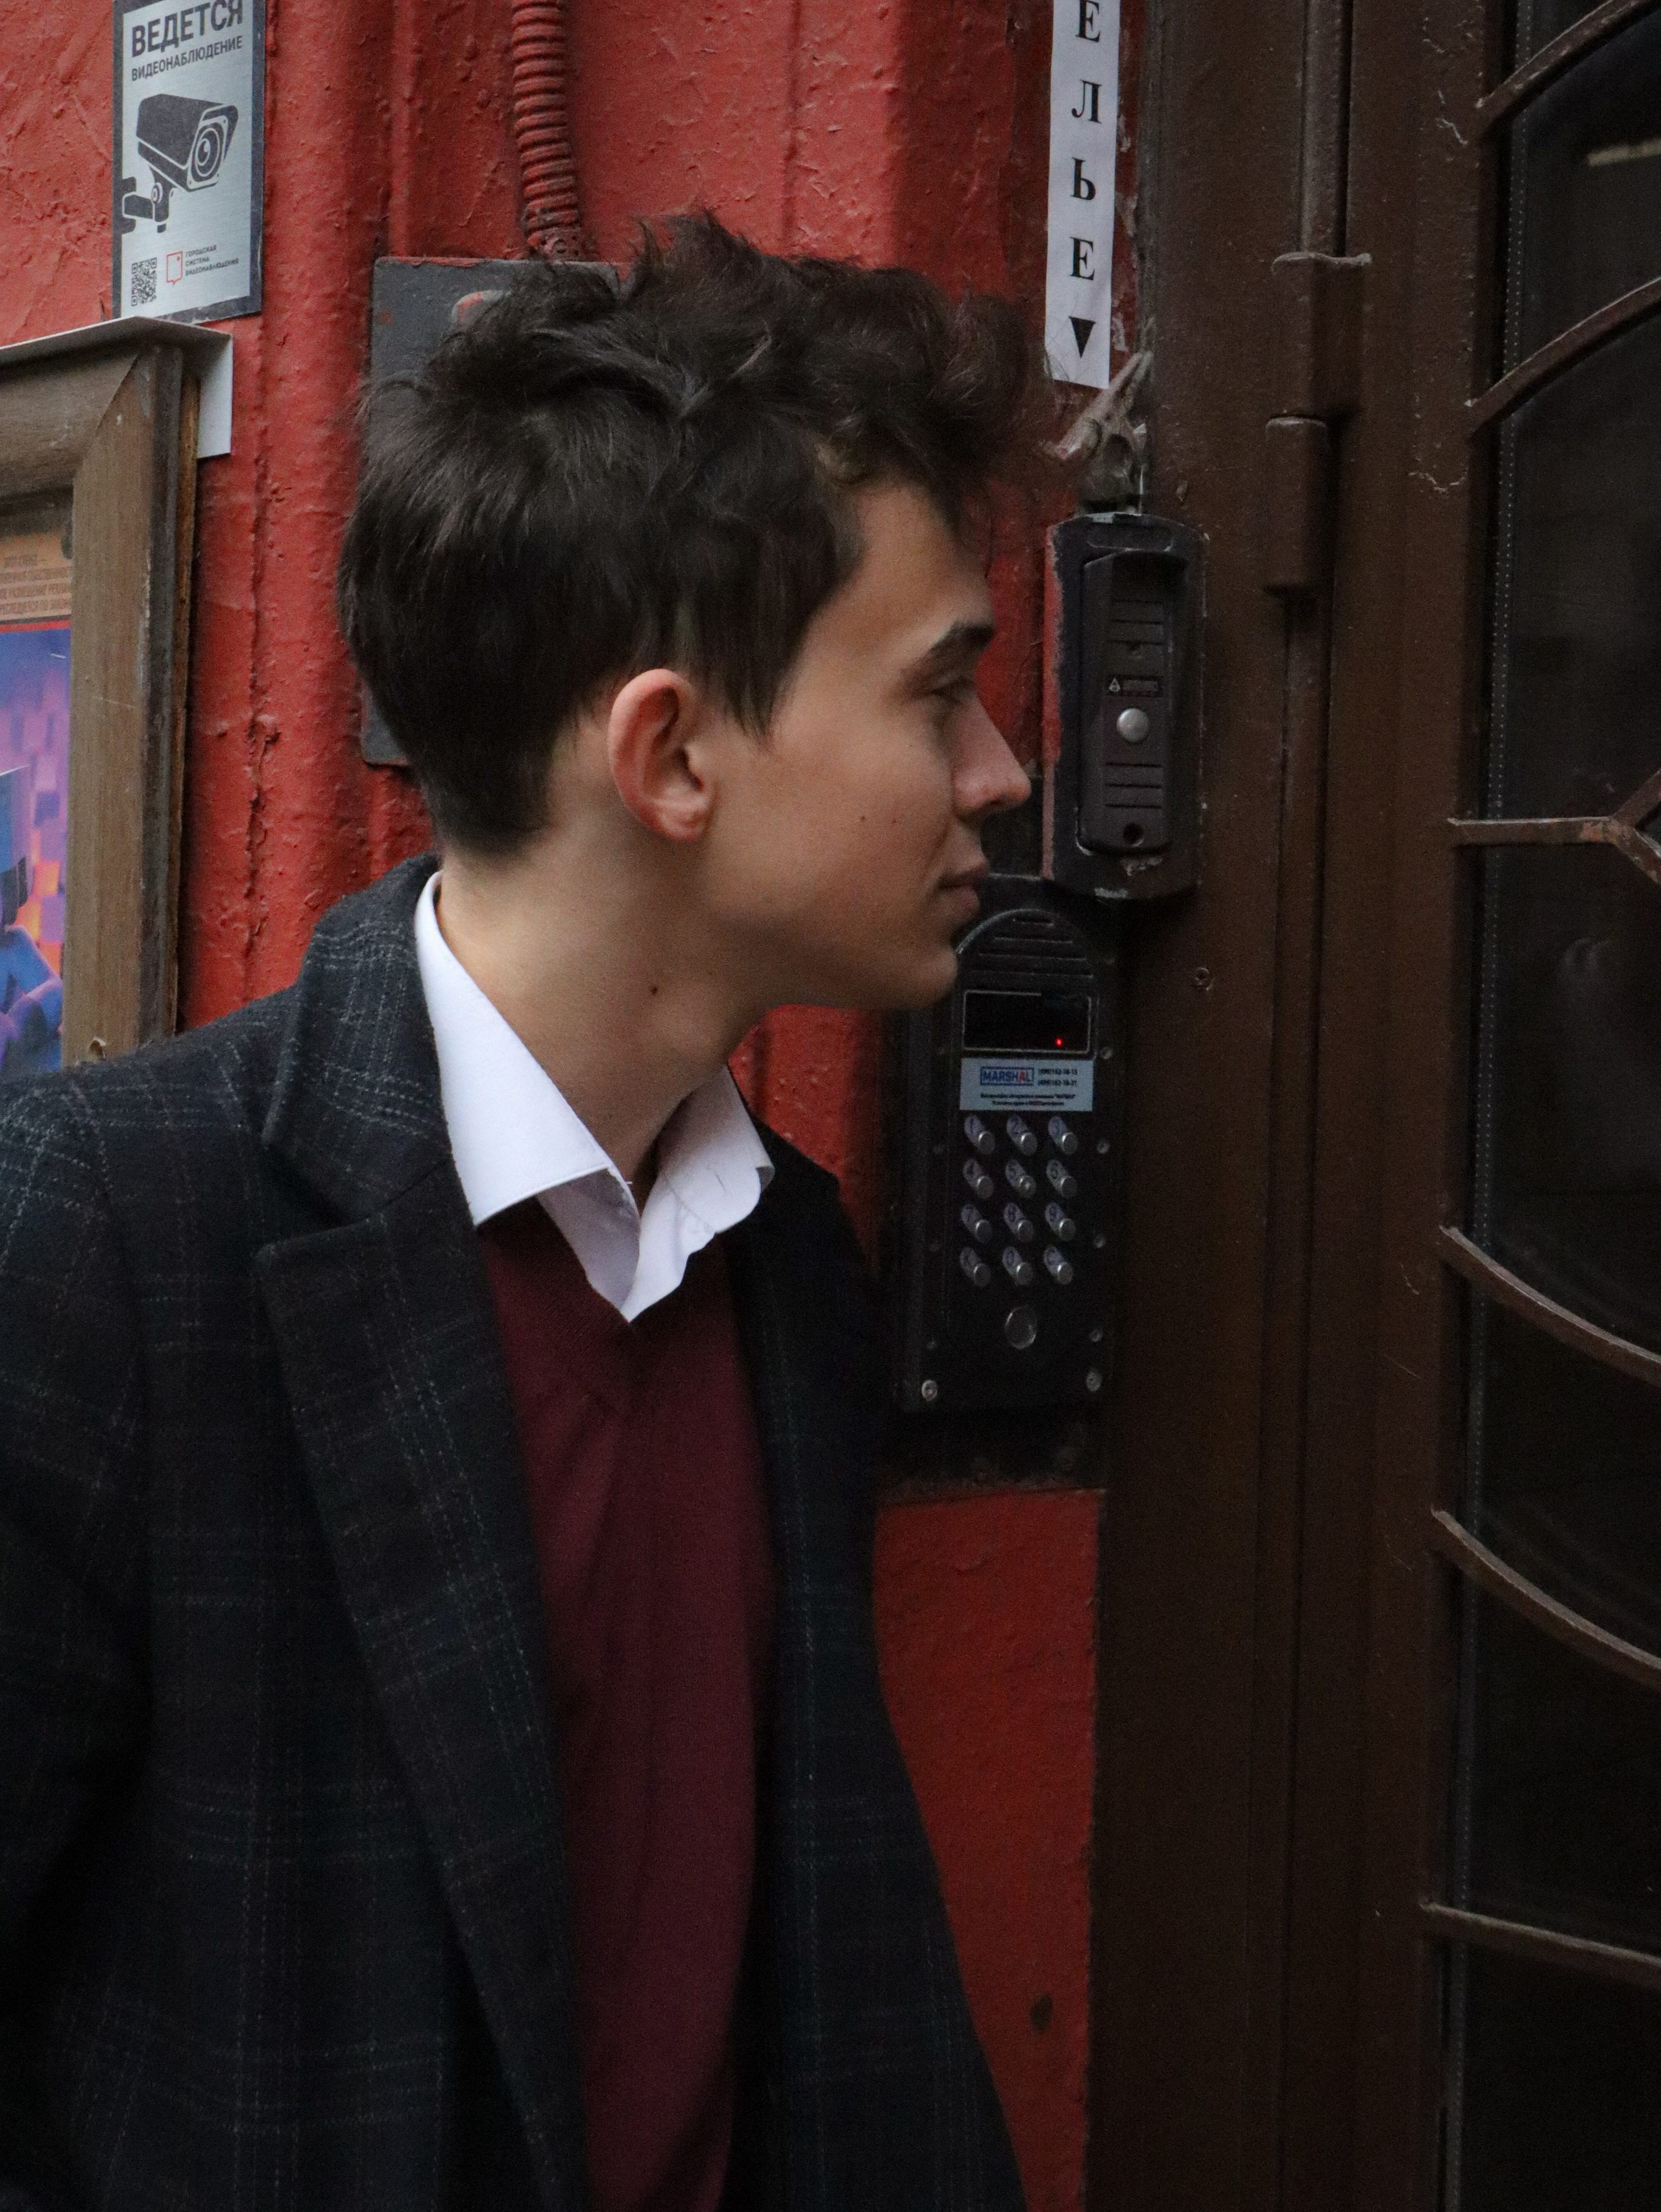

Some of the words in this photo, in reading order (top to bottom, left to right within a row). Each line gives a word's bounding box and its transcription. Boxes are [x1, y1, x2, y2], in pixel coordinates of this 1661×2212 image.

[132, 0, 243, 58] ВЕДЕТСЯ
[131, 35, 243, 82] ВИДЕОНАБЛЮДЕНИЕ
[186, 245, 217, 258] ГОРОДСКАЯ
[186, 256, 210, 267] СИСТЕМА
[983, 1070, 1032, 1083] MARSHAL
